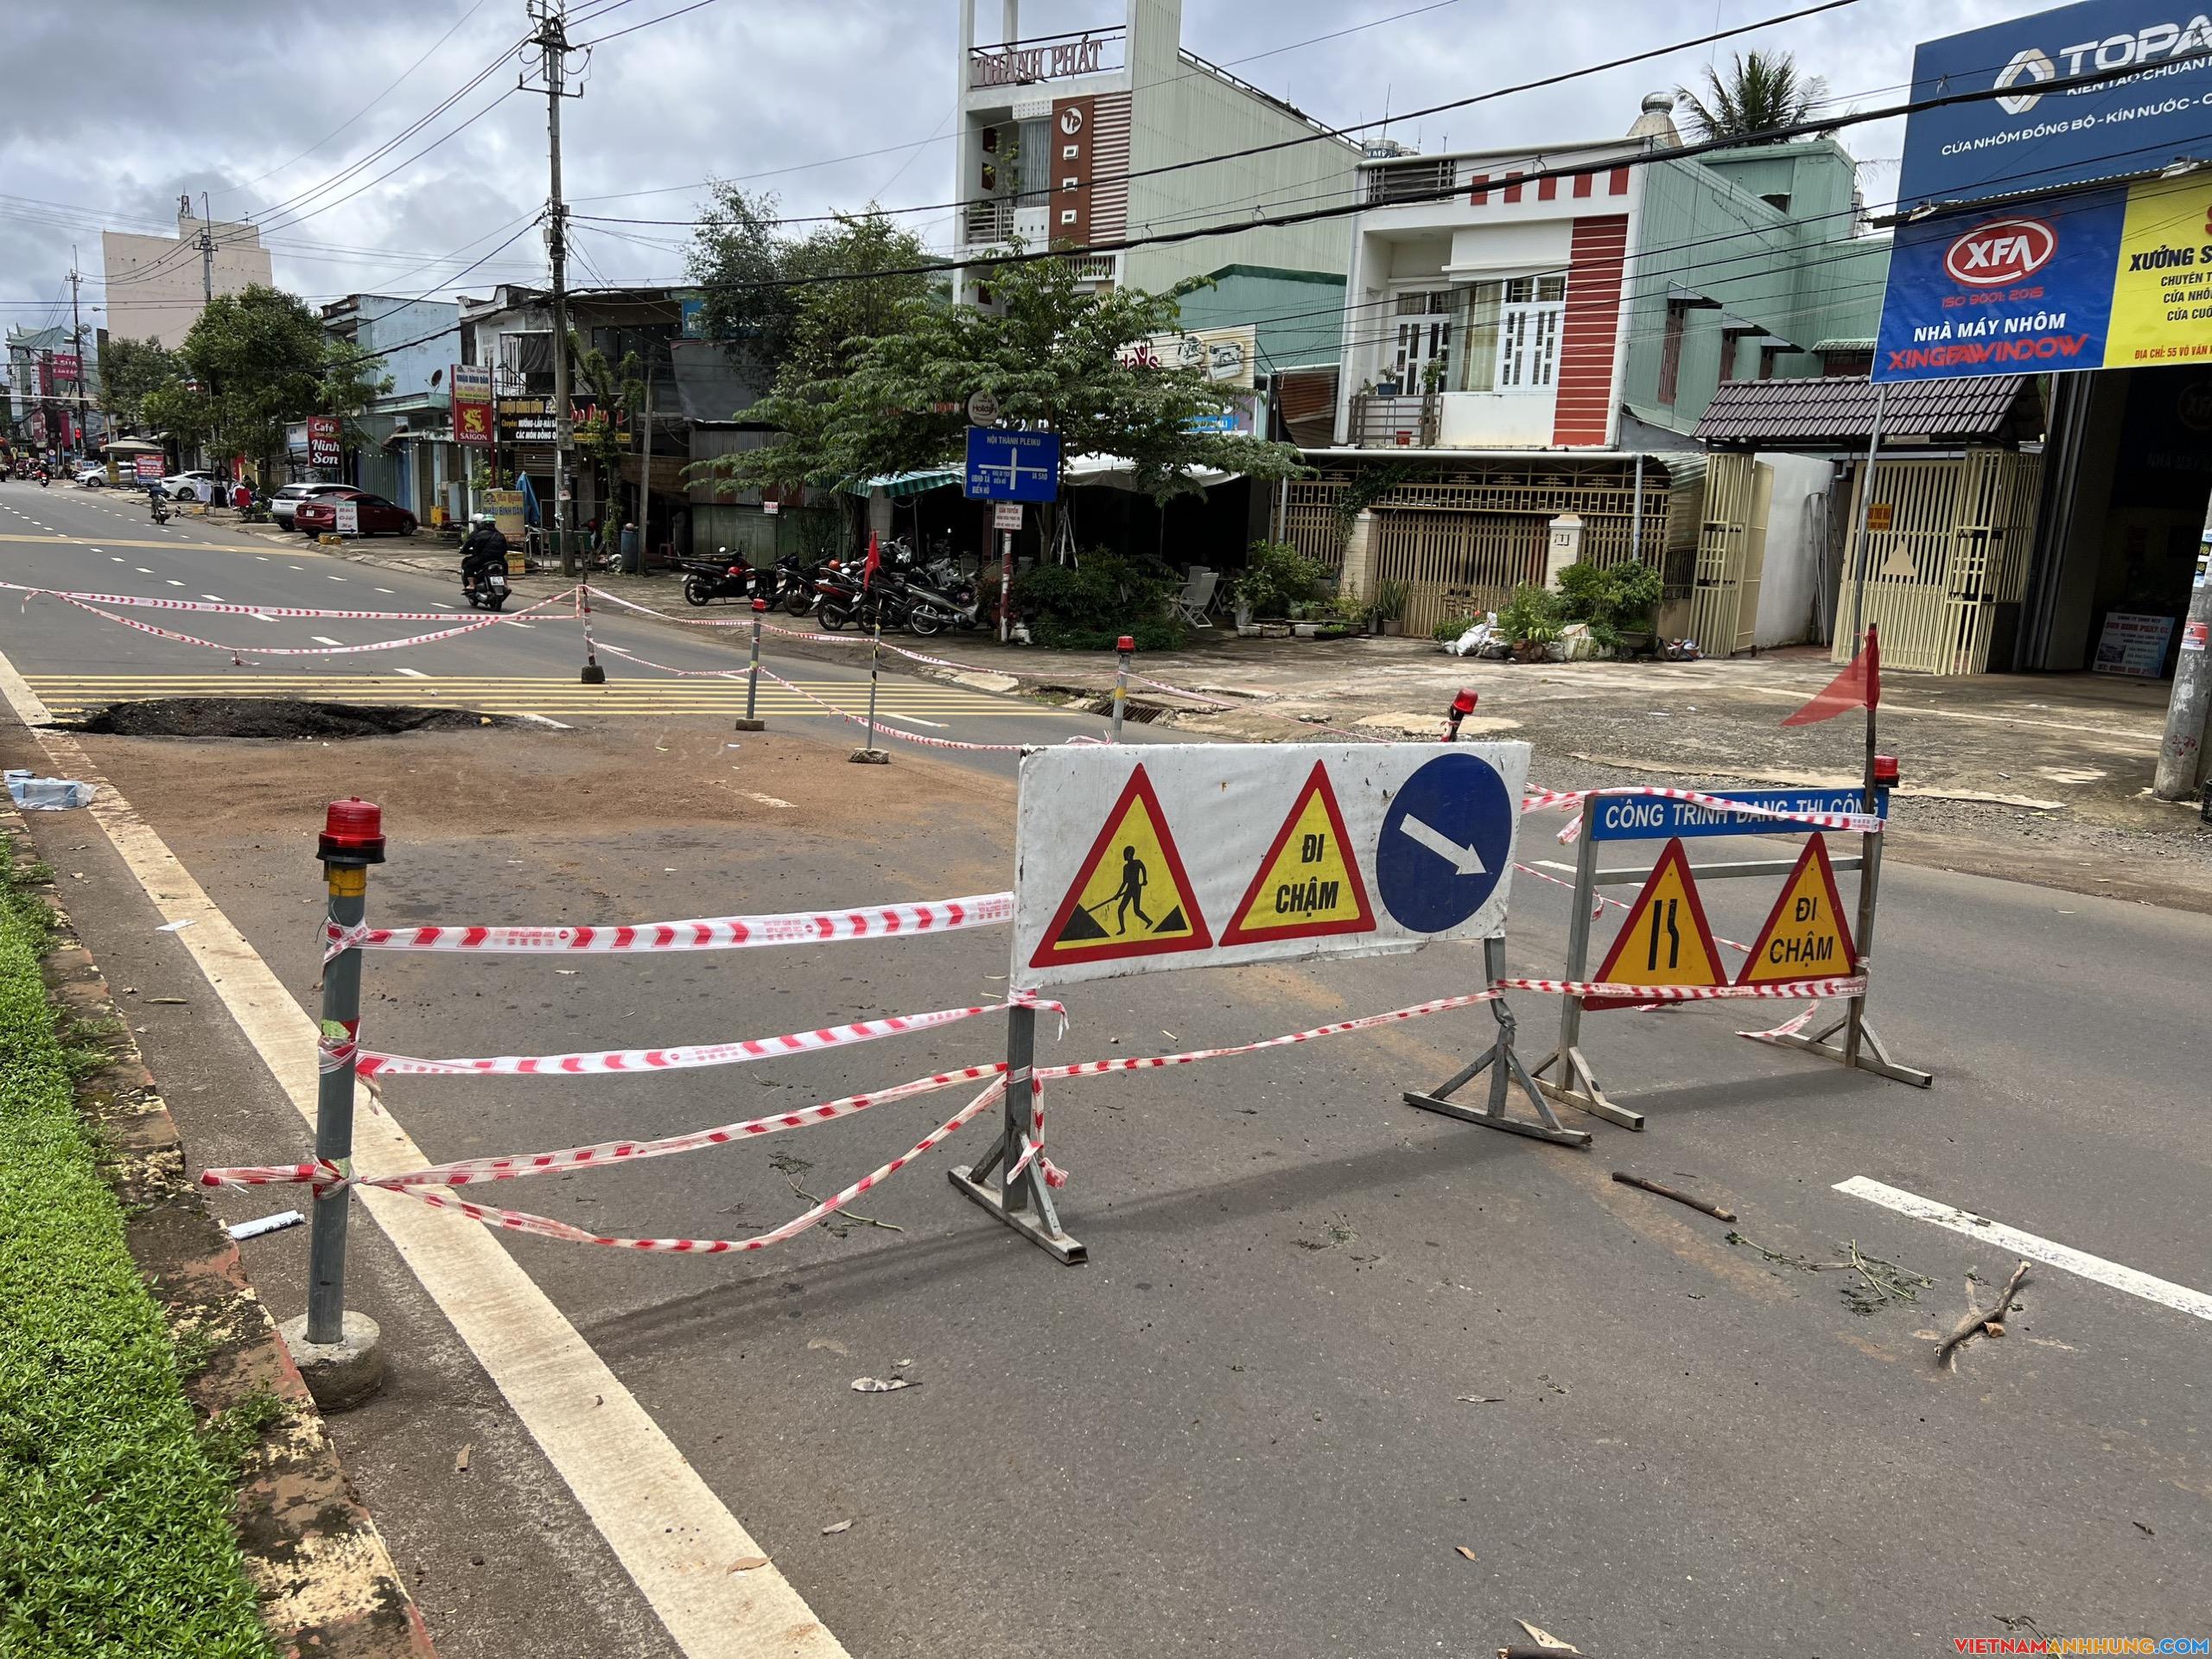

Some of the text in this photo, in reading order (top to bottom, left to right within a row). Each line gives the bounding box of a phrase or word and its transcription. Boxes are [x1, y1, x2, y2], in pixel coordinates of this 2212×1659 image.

[976, 34, 1103, 86] THÀNH PHÁT
[1974, 130, 2020, 149] NHÔM
[2071, 114, 2095, 130] BỘ
[2106, 107, 2135, 125] KÍN
[2137, 97, 2190, 118] NƯỚC
[2128, 245, 2195, 271] XƯỞNG
[2161, 271, 2203, 286] CHUYÊN
[1942, 296, 1966, 308] ISO
[2164, 287, 2212, 303] CỬA NHÔ
[1914, 311, 2067, 342] NHÀ MÁY NHÔM
[2167, 307, 2189, 321] CỬA
[2167, 347, 2177, 357] 55
[460, 432, 487, 441] SAIGON
[999, 435, 1019, 445] THÀNH
[1020, 437, 1040, 447] PLEIKU
[1605, 798, 1664, 829] CÔNG
[1796, 798, 1824, 813] THI
[1301, 833, 1325, 863] ĐI
[1275, 876, 1339, 918] CHẬM
[1796, 896, 1818, 923] ĐI
[1769, 930, 1834, 968] CHẬM
